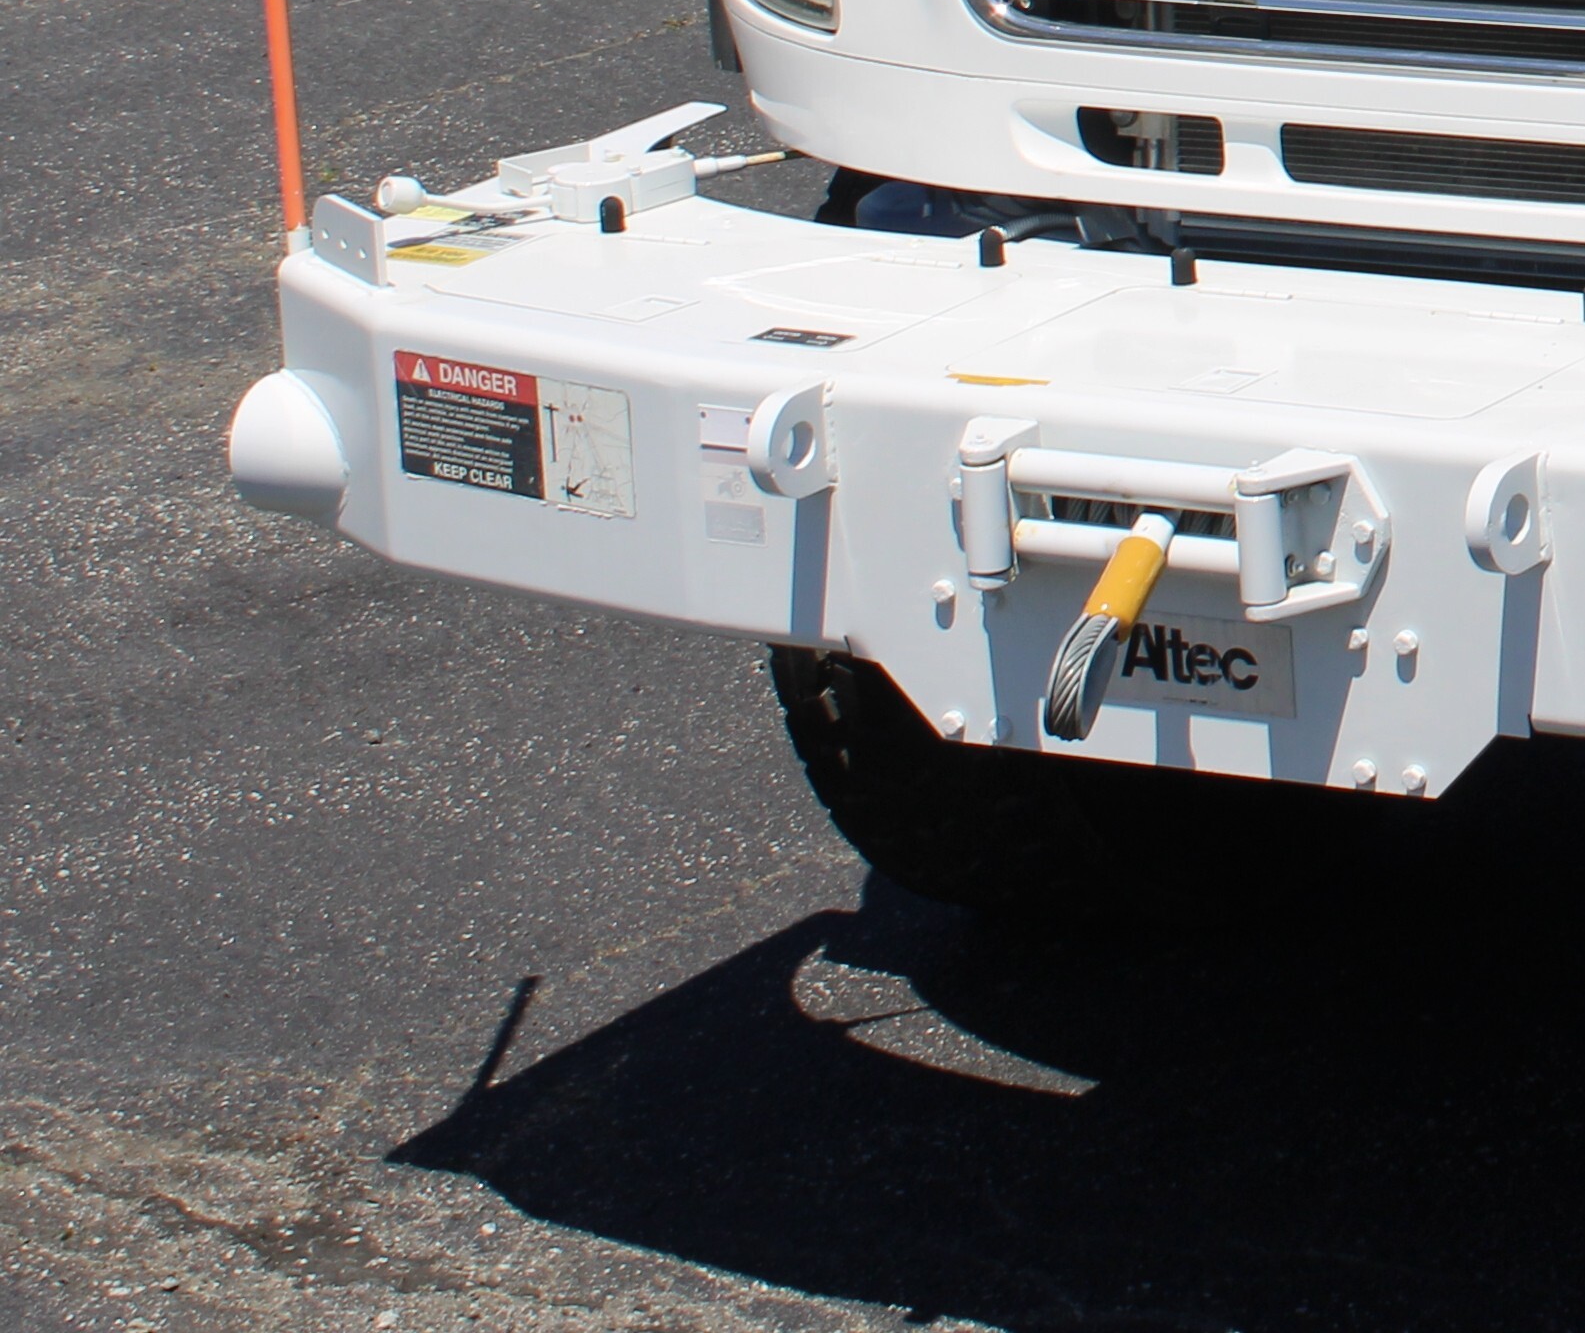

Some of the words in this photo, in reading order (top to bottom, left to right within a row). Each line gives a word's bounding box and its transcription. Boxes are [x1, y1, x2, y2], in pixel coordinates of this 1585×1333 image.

[438, 362, 517, 397] DANGER
[433, 461, 468, 480] KEEP
[469, 468, 513, 490] CLEAR
[1121, 623, 1259, 690] Altec
